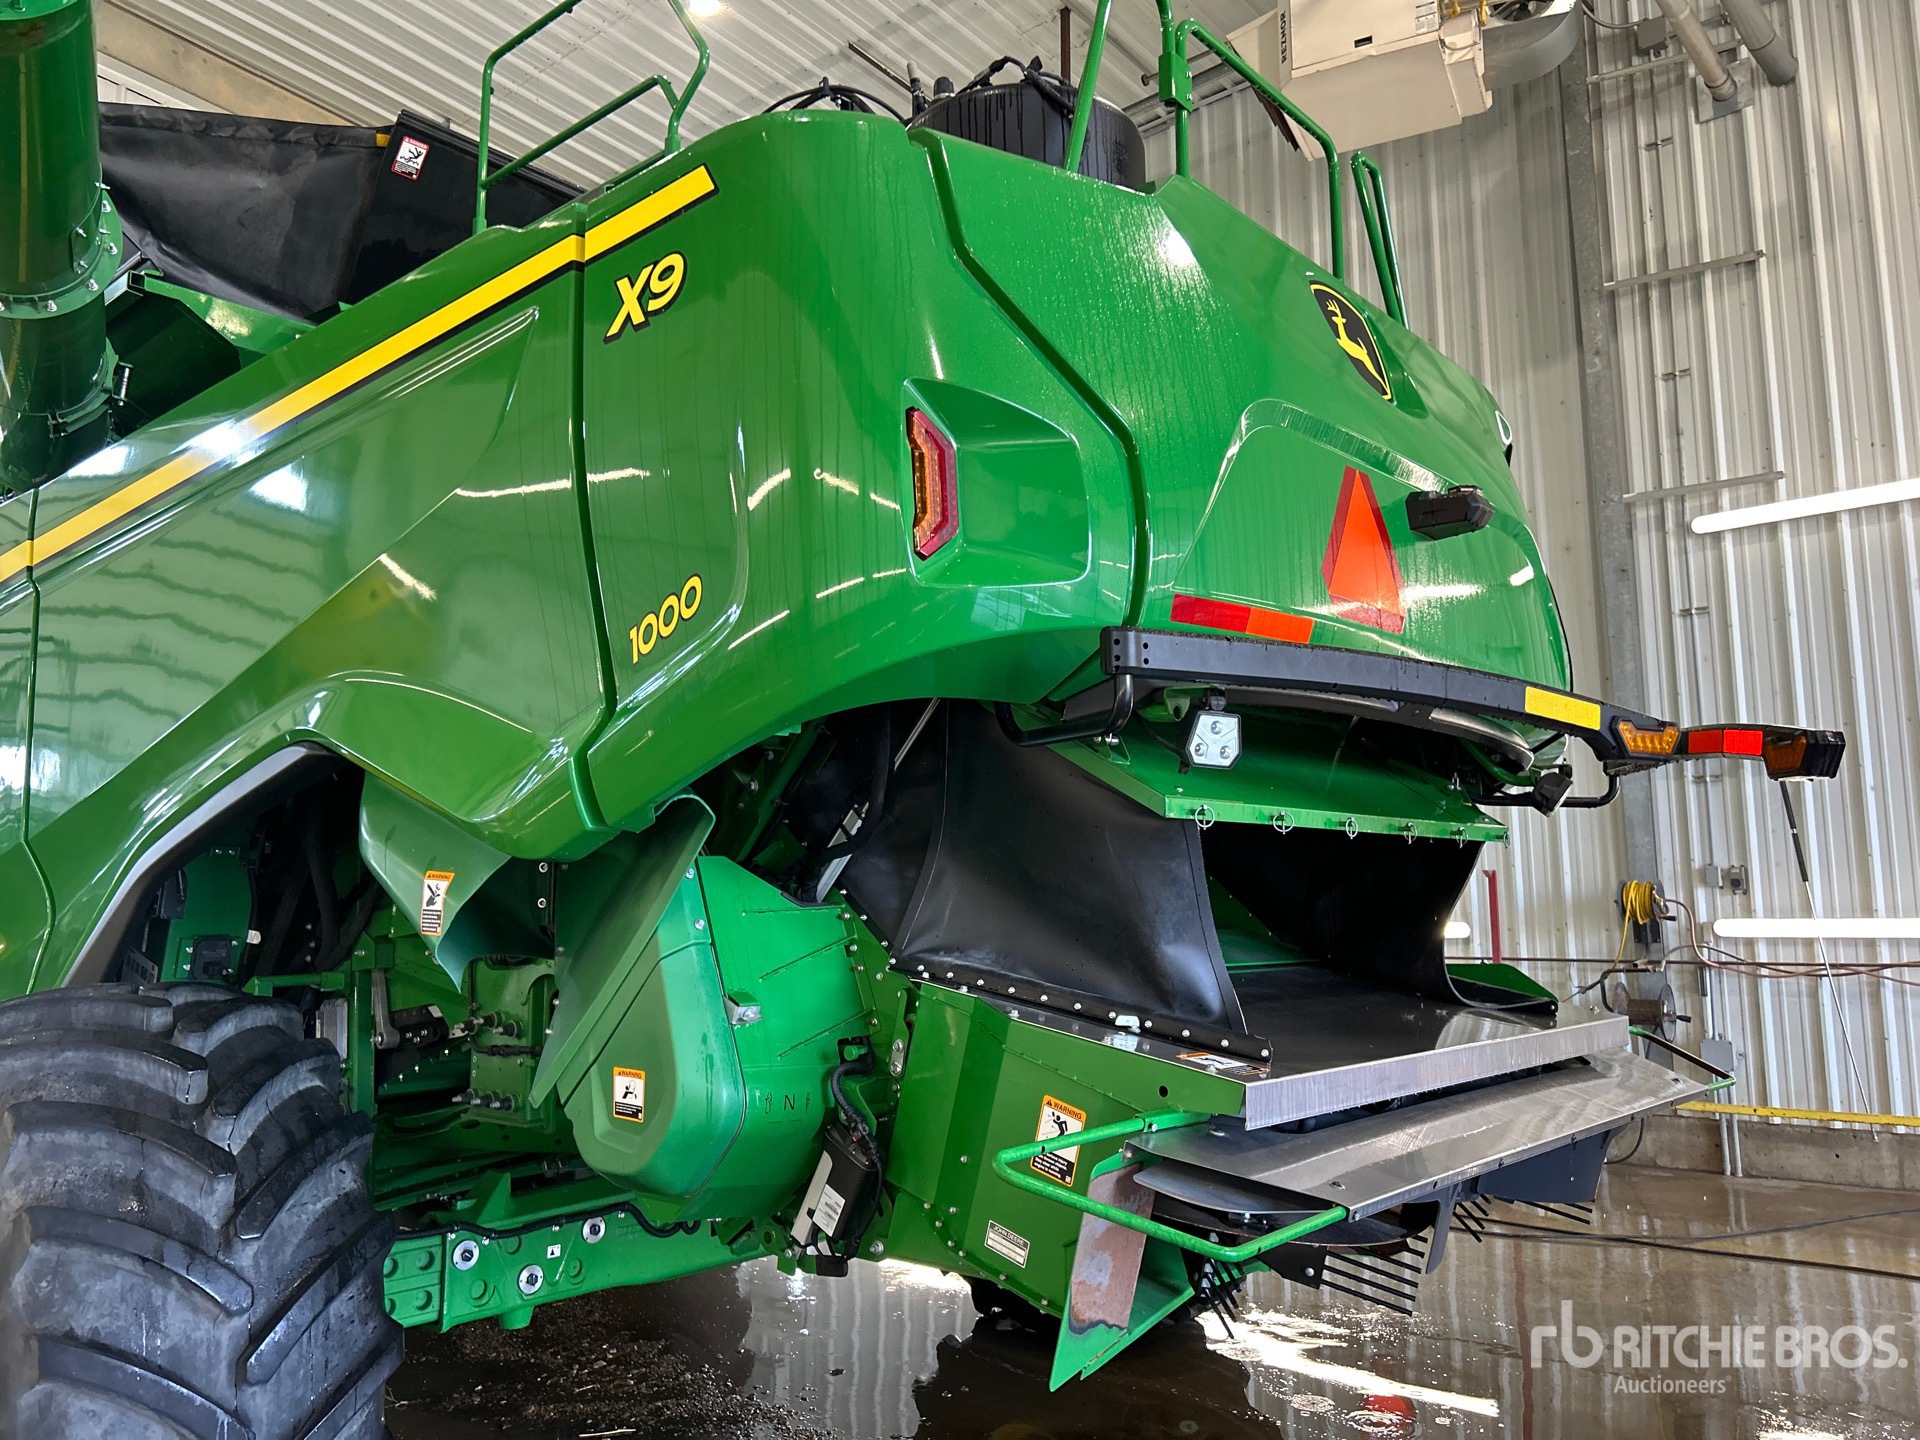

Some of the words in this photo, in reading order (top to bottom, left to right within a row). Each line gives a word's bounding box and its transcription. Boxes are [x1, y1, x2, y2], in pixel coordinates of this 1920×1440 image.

[604, 251, 687, 343] X9
[629, 574, 703, 664] 1000
[620, 1070, 642, 1079] WARNING
[1053, 1102, 1082, 1120] WARNING
[993, 1225, 1008, 1236] JOHN
[1007, 1232, 1025, 1246] DEERE
